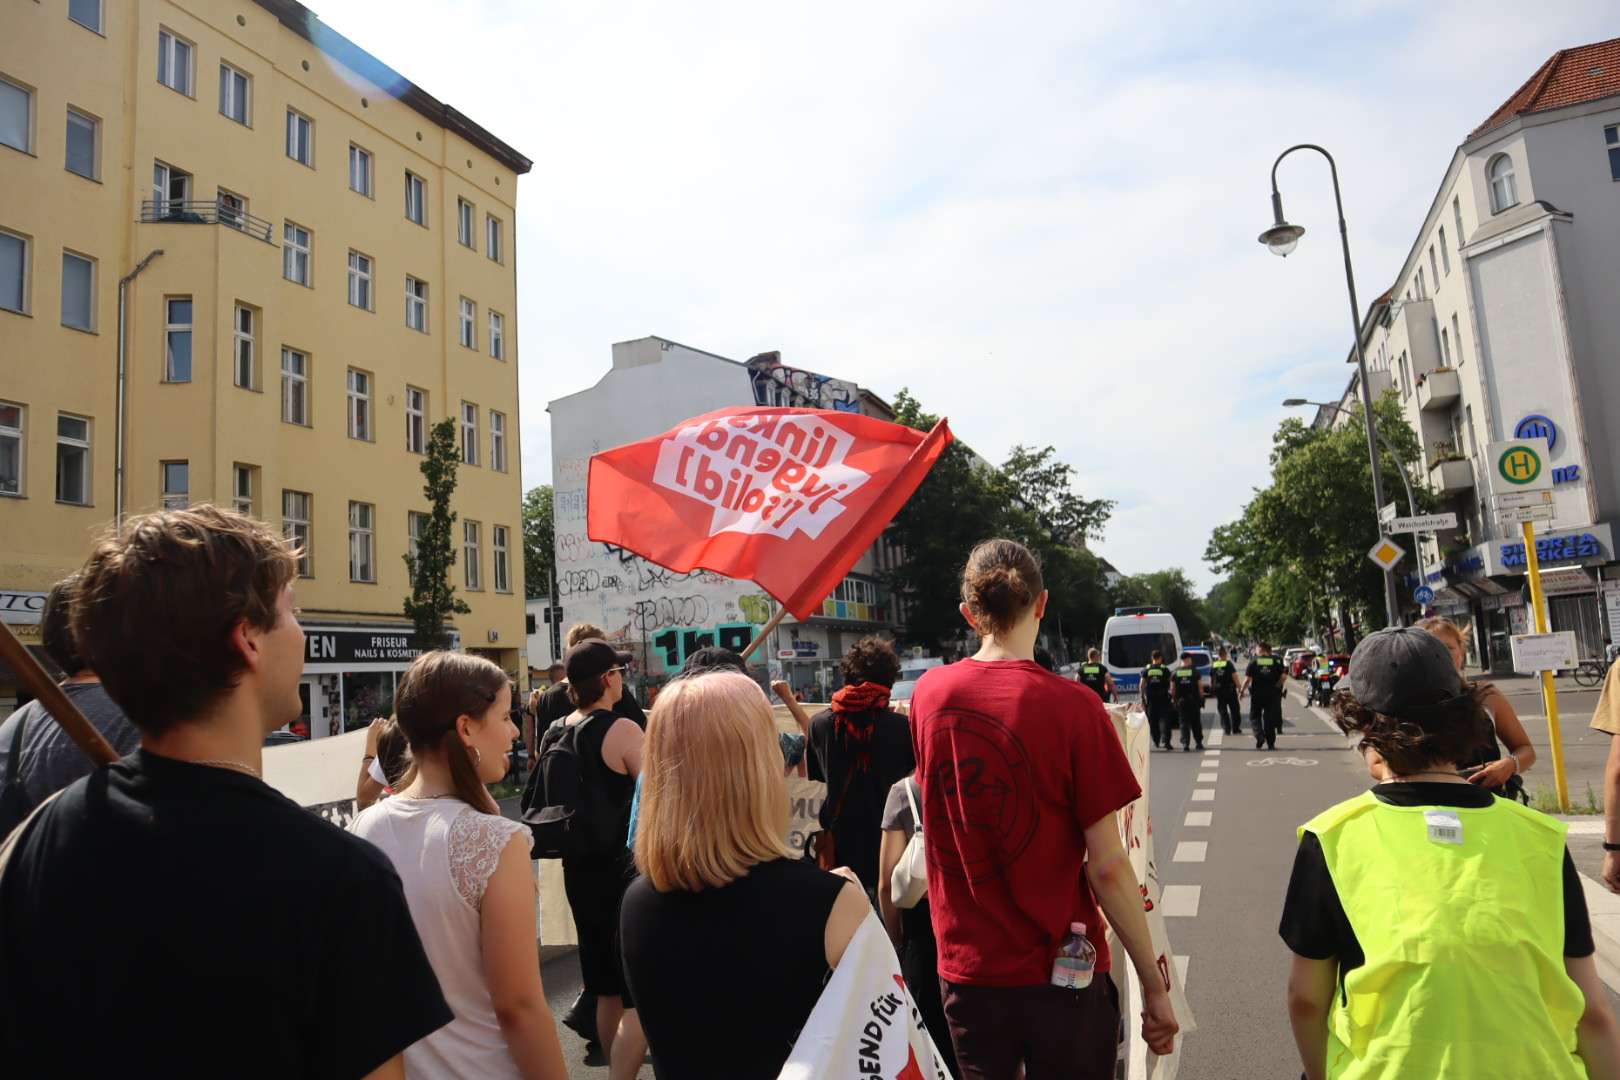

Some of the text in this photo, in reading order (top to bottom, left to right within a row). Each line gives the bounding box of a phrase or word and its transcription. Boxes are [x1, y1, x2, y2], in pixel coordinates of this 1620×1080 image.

[1511, 454, 1531, 477] H
[1552, 464, 1581, 484] nz
[0, 594, 48, 610] TO
[304, 635, 336, 658] EN
[371, 636, 408, 648] FRISEUR
[354, 649, 378, 658] NAILS
[870, 993, 903, 1026] für
